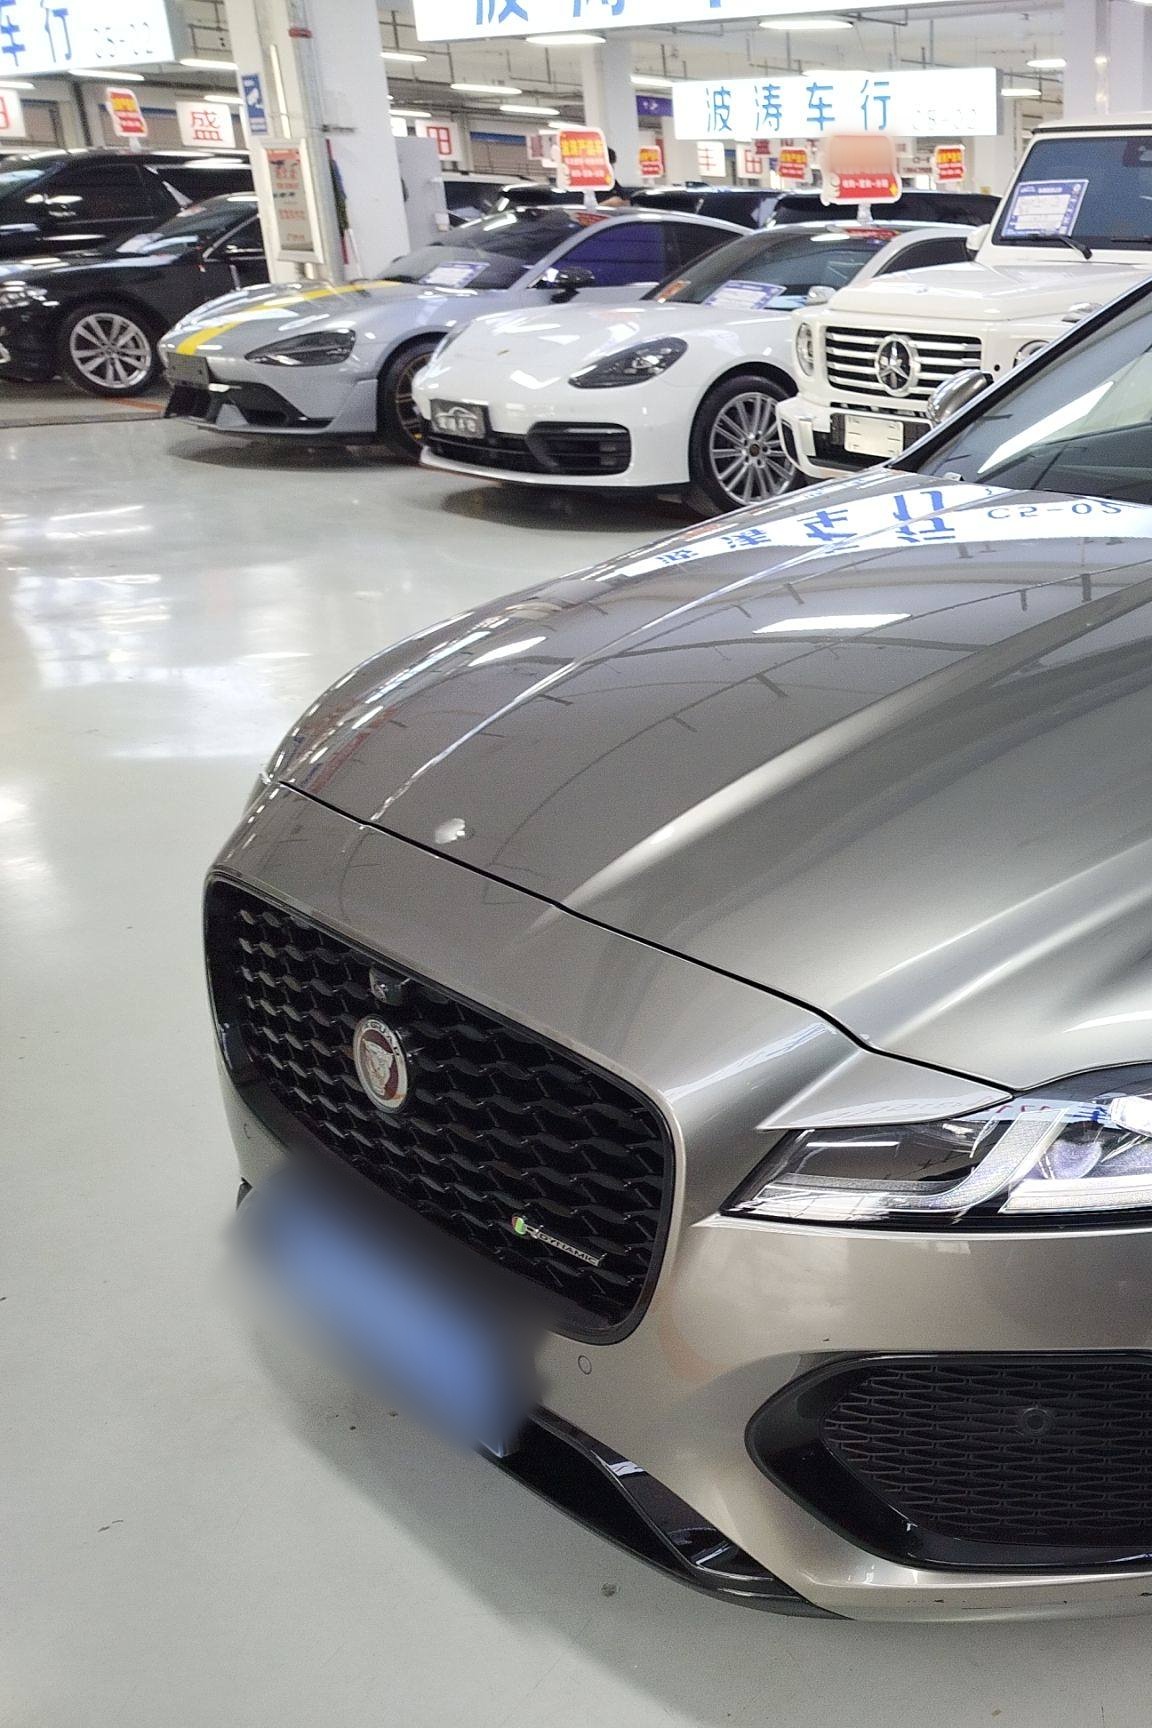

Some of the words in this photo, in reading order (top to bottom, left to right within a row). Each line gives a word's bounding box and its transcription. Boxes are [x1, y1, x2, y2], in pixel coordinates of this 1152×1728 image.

[190, 109, 224, 142] 盛
[705, 79, 891, 132] 波涛车行
